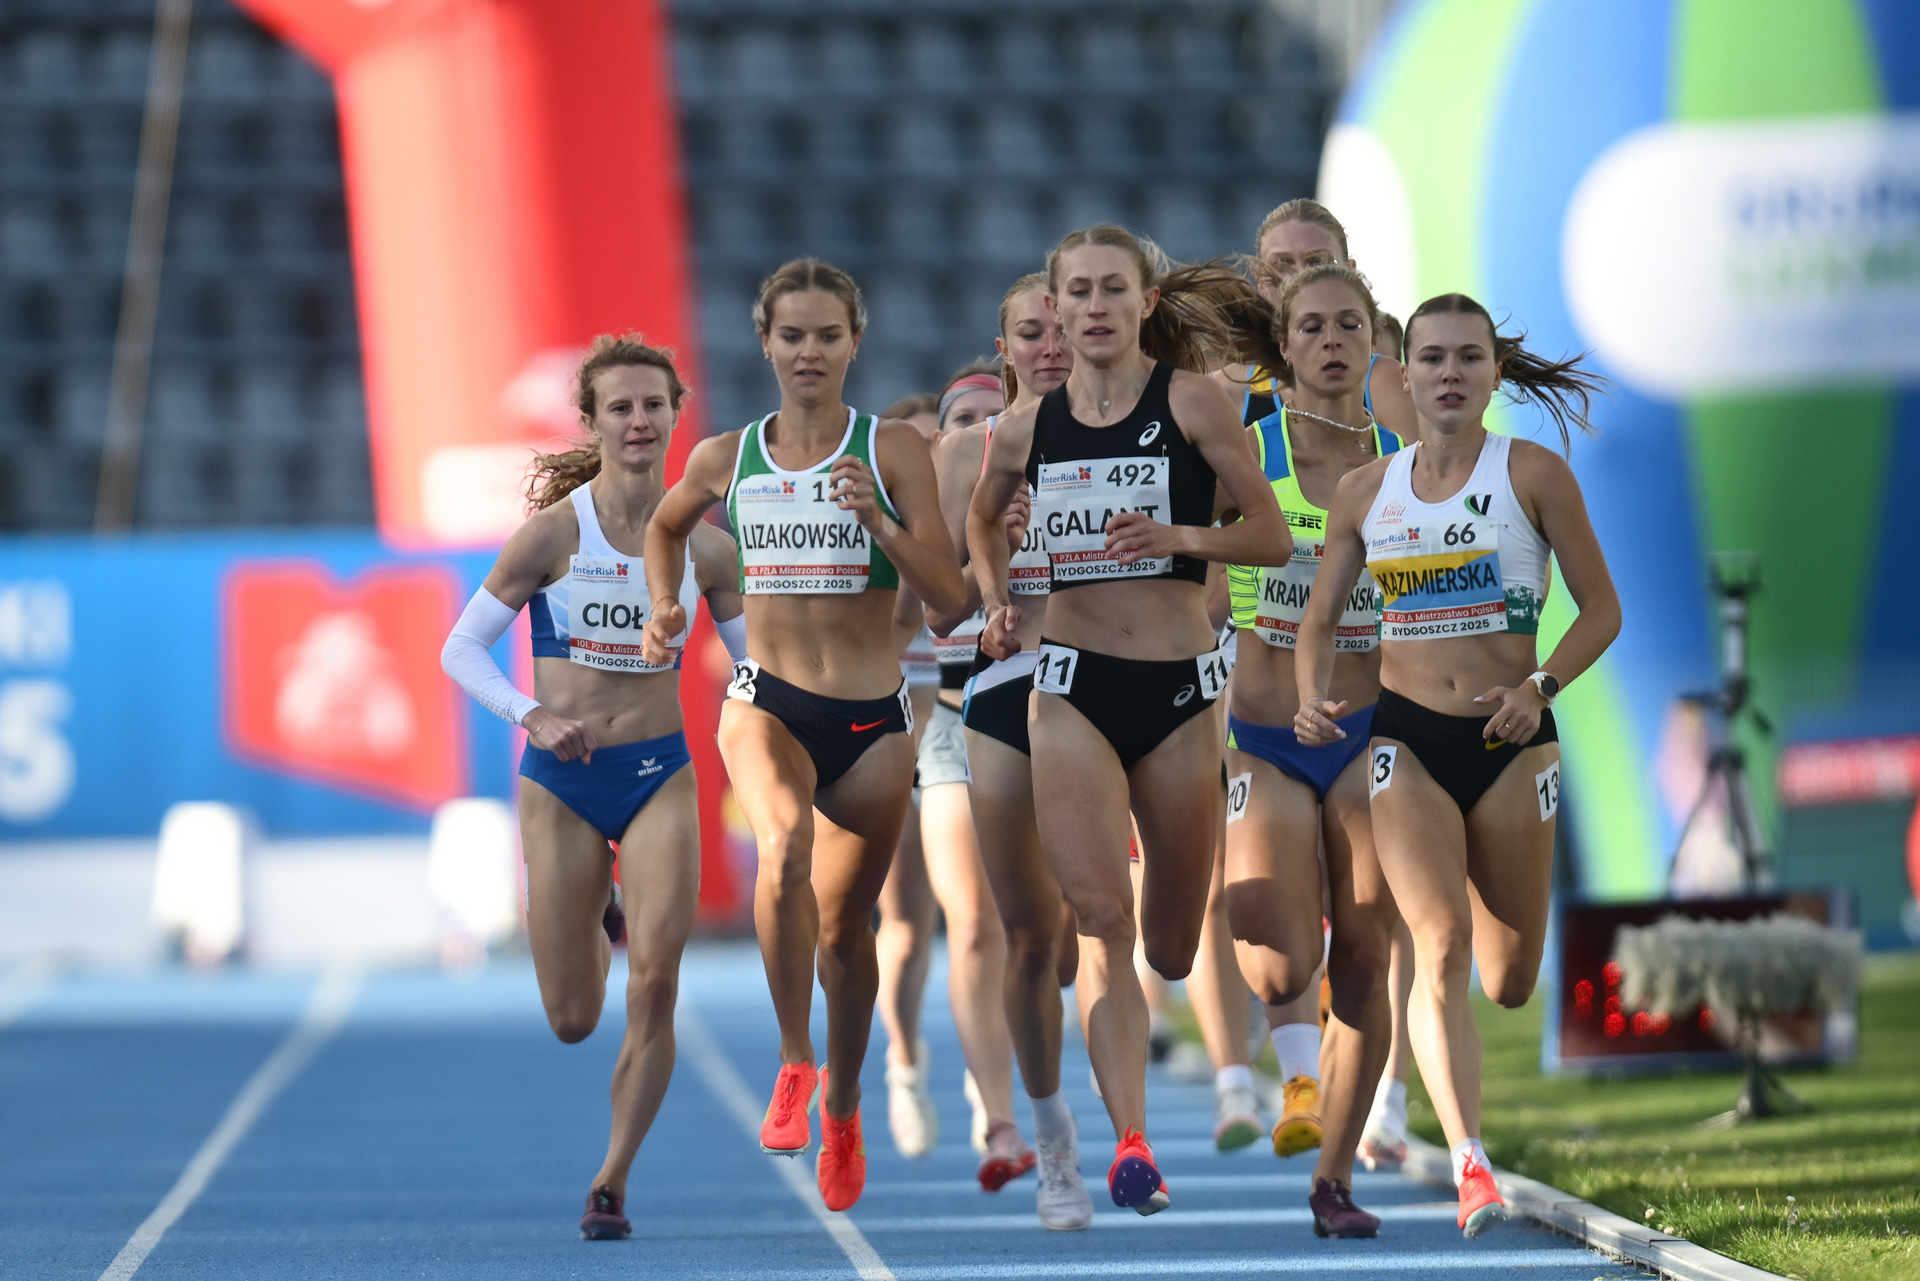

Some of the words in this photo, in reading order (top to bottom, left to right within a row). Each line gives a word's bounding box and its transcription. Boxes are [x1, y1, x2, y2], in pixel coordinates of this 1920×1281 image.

[1041, 474, 1078, 485] InterRisk
[1106, 463, 1156, 487] 492
[740, 485, 781, 495] InterRisk
[1046, 505, 1159, 537] GALAT
[743, 523, 866, 549] LIZAKOWSKA
[1372, 533, 1407, 548] InterRisk
[1444, 523, 1476, 546] 66
[1060, 554, 1080, 562] PZLA
[573, 565, 615, 576] InterRisk
[760, 566, 777, 575] PZLA
[779, 566, 834, 575] Mistrzostwa
[837, 566, 862, 575] Polski
[1021, 569, 1041, 577] PZLA
[1127, 561, 1156, 572] 2025
[755, 579, 821, 589] BYDGOSZCZ
[823, 579, 853, 589] 2025
[1376, 562, 1498, 597] KAZIMIERSKA
[1415, 608, 1470, 621] Mistrzostwa
[1471, 603, 1498, 616] Polski
[1263, 618, 1276, 628] 101.
[1392, 622, 1458, 636] BYDGOSZCZ
[1460, 619, 1490, 631] 2025
[577, 639, 590, 650] 101.
[592, 644, 611, 653] PZLA
[1344, 639, 1370, 649] 2025
[585, 653, 650, 668] BYDGOSZCZ
[1038, 652, 1072, 686] 11
[1228, 780, 1248, 816] 10
[1539, 770, 1560, 811] 13
